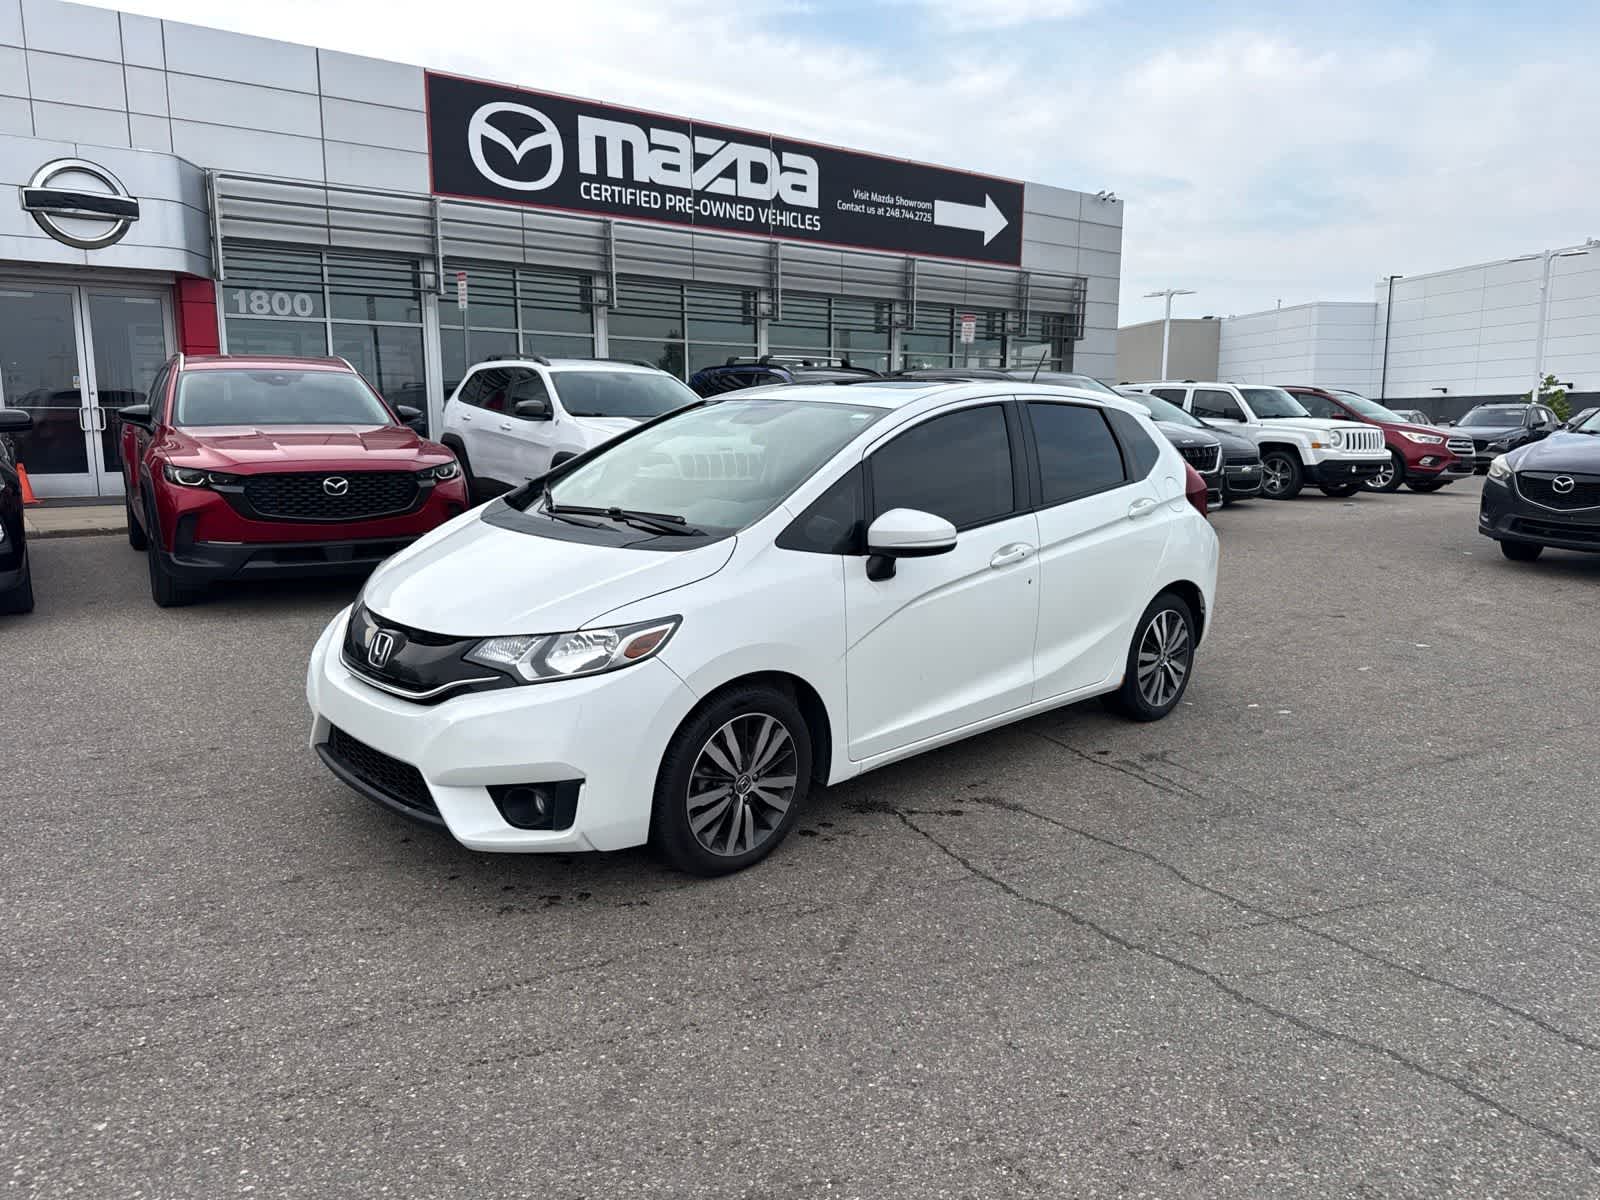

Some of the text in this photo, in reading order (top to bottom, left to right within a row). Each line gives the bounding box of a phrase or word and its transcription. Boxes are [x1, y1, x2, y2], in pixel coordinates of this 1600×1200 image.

[580, 181, 821, 231] CERTIFIED PRE-OWNED VEHICLES
[852, 188, 933, 209] Visit Mazda Showroom
[837, 200, 932, 223] Contact us at 248.744.2725
[232, 289, 314, 317] 1800
